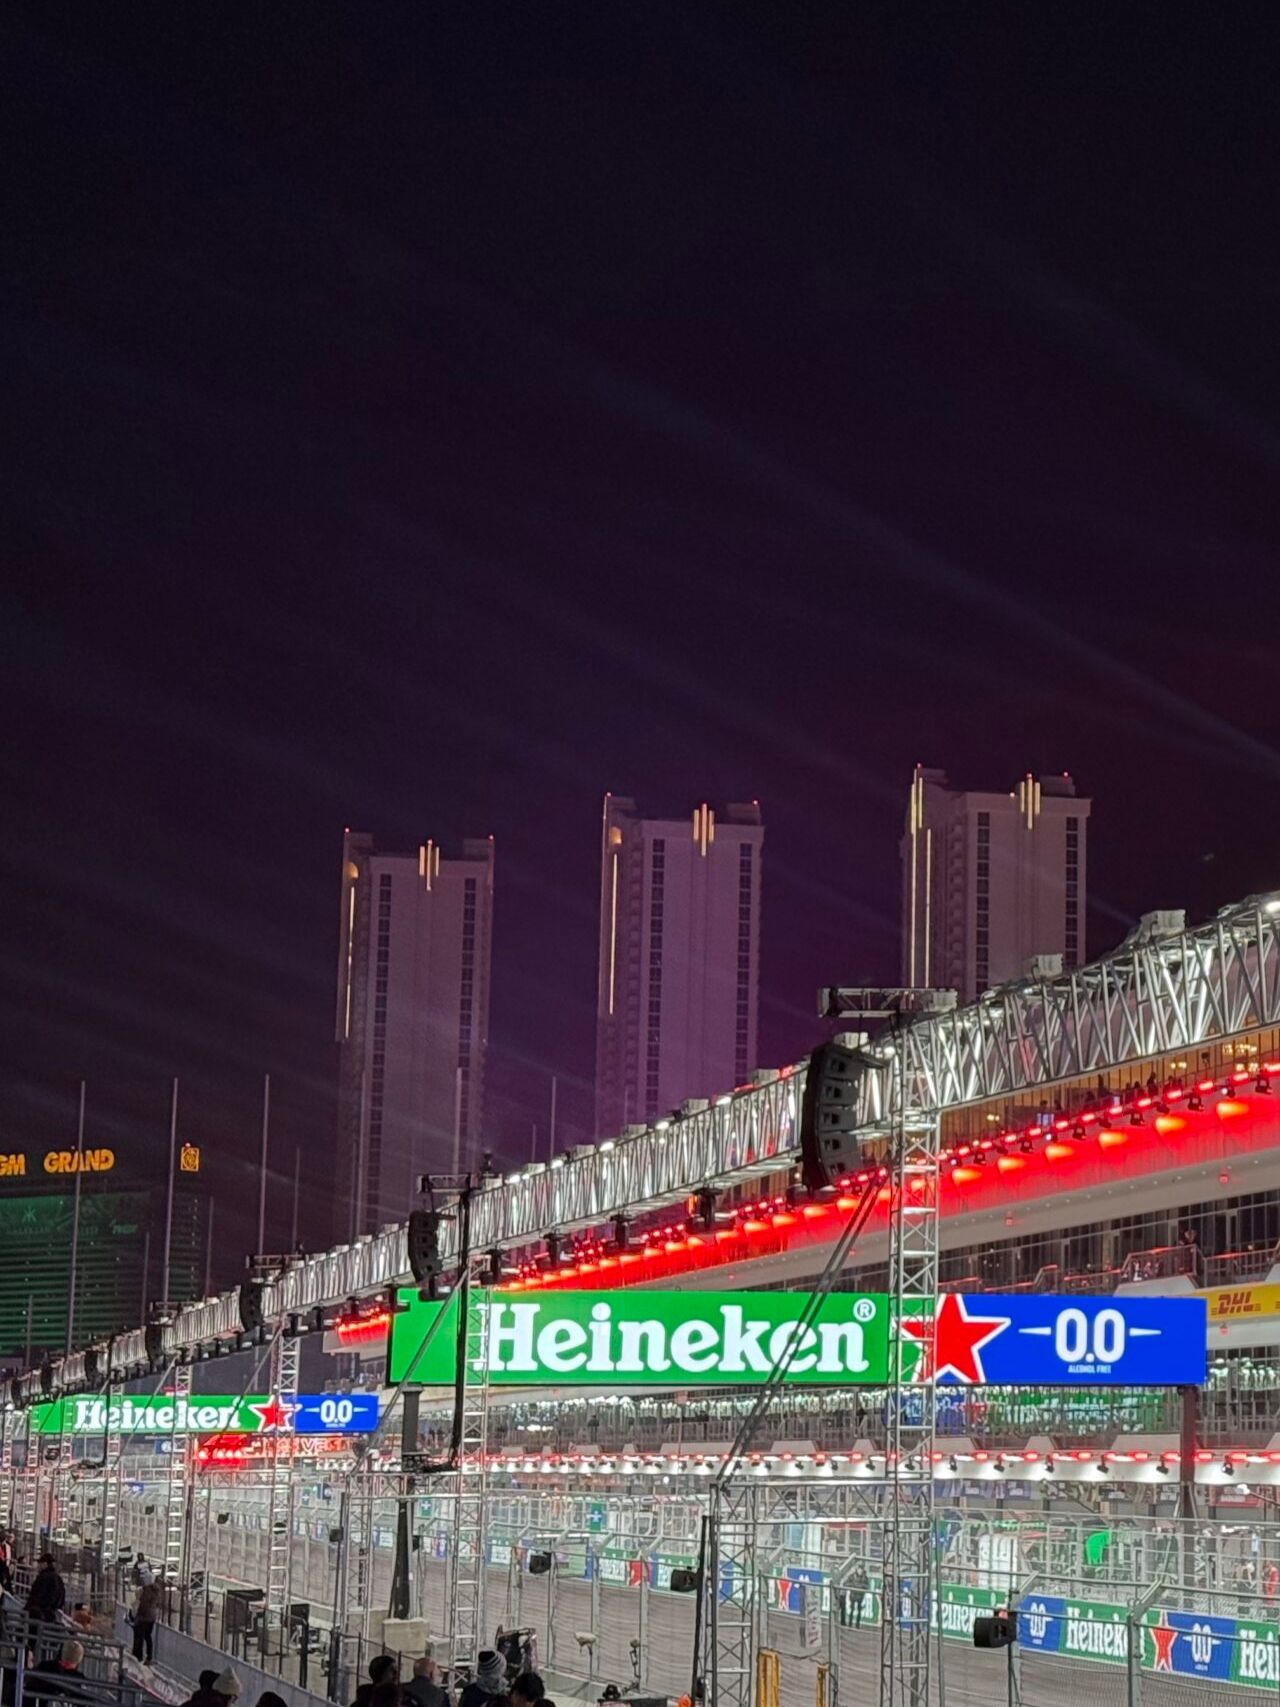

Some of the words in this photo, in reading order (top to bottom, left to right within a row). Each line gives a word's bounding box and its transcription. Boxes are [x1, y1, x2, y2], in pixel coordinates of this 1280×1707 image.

[44, 1149, 115, 1173] GRAND
[1218, 1291, 1254, 1315] DHL
[474, 1302, 869, 1373] Heineken
[1055, 1308, 1126, 1363] 0.0
[1096, 1365, 1111, 1374] FREE
[74, 1400, 241, 1429] Heineken
[320, 1399, 353, 1424] 0.0
